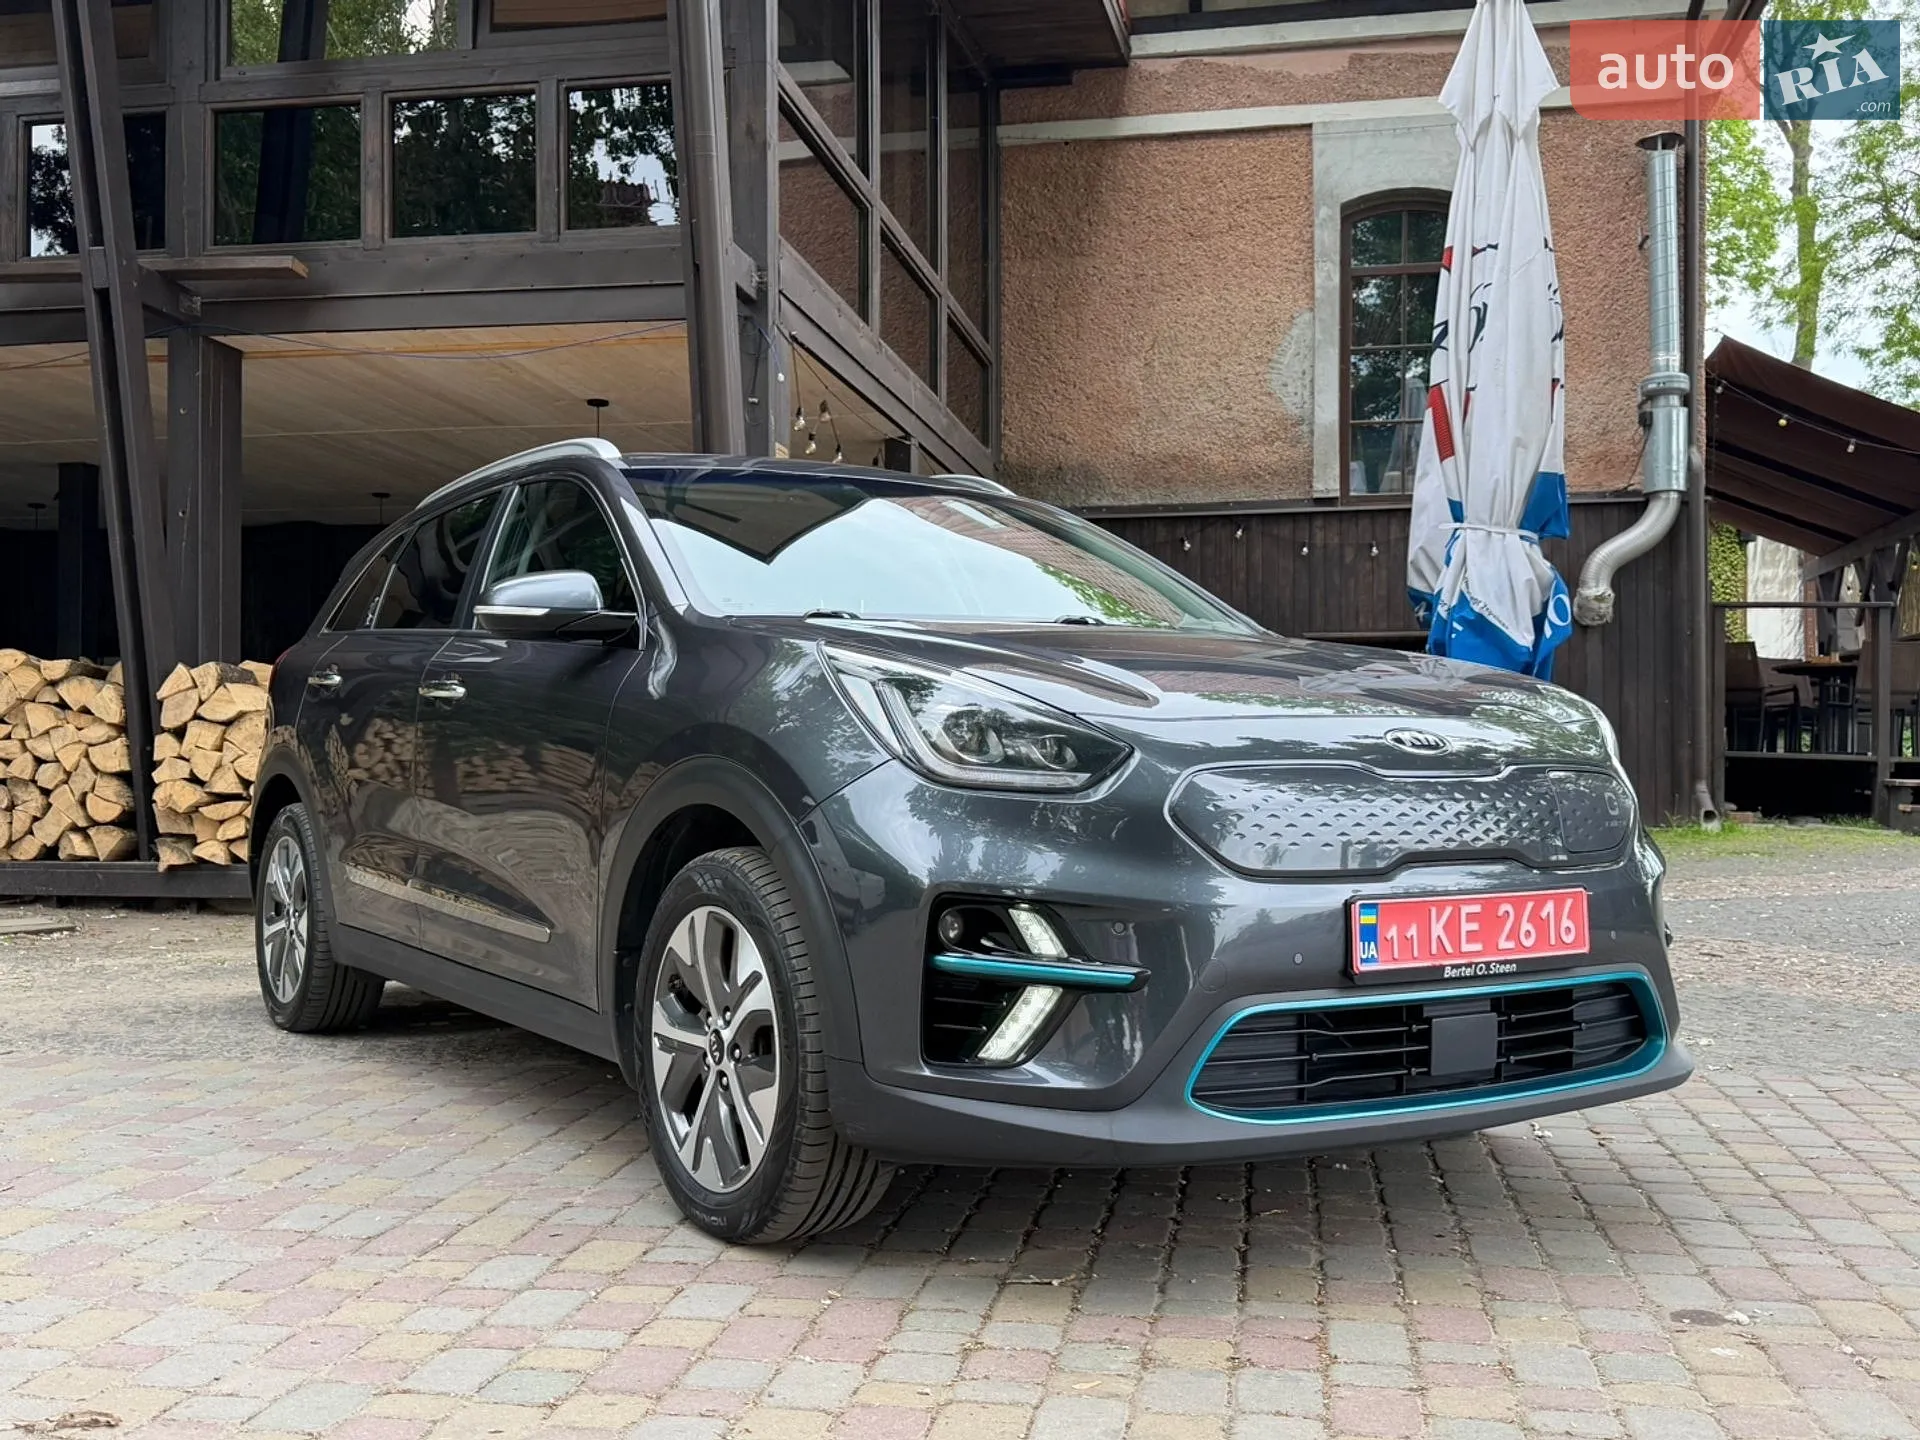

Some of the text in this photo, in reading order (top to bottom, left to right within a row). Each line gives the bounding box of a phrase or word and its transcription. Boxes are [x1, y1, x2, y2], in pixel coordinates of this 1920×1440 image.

[1391, 731, 1445, 747] KIA
[1385, 898, 1576, 960] 11 KE 2616
[1360, 941, 1377, 959] UA
[1444, 962, 1517, 978] Bertel O. Steen
